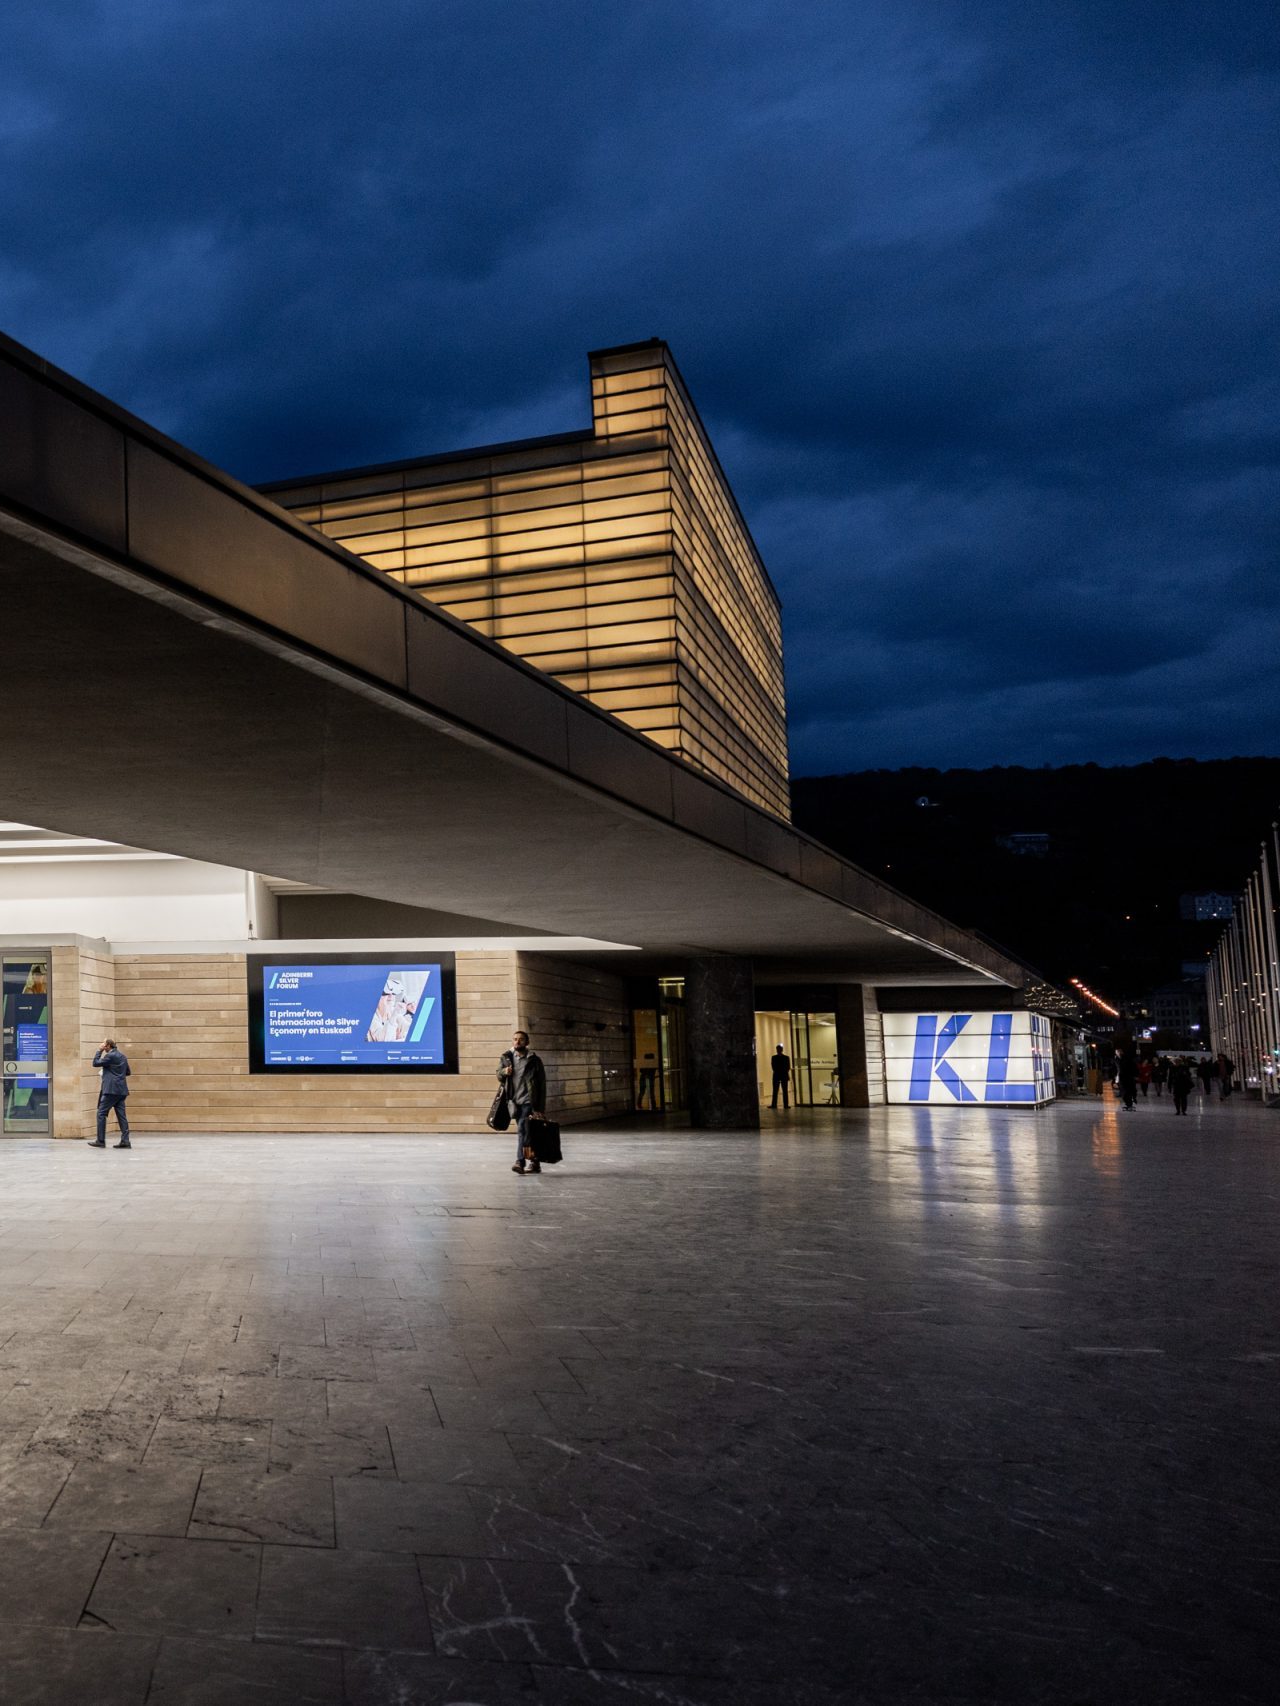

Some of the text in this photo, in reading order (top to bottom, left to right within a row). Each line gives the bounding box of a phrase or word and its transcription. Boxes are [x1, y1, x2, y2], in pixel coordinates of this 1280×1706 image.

[269, 1010, 323, 1019] El primer foro
[270, 1018, 360, 1026] internacional de Silver
[270, 1027, 307, 1037] Economy
[320, 1026, 352, 1034] Euskadi
